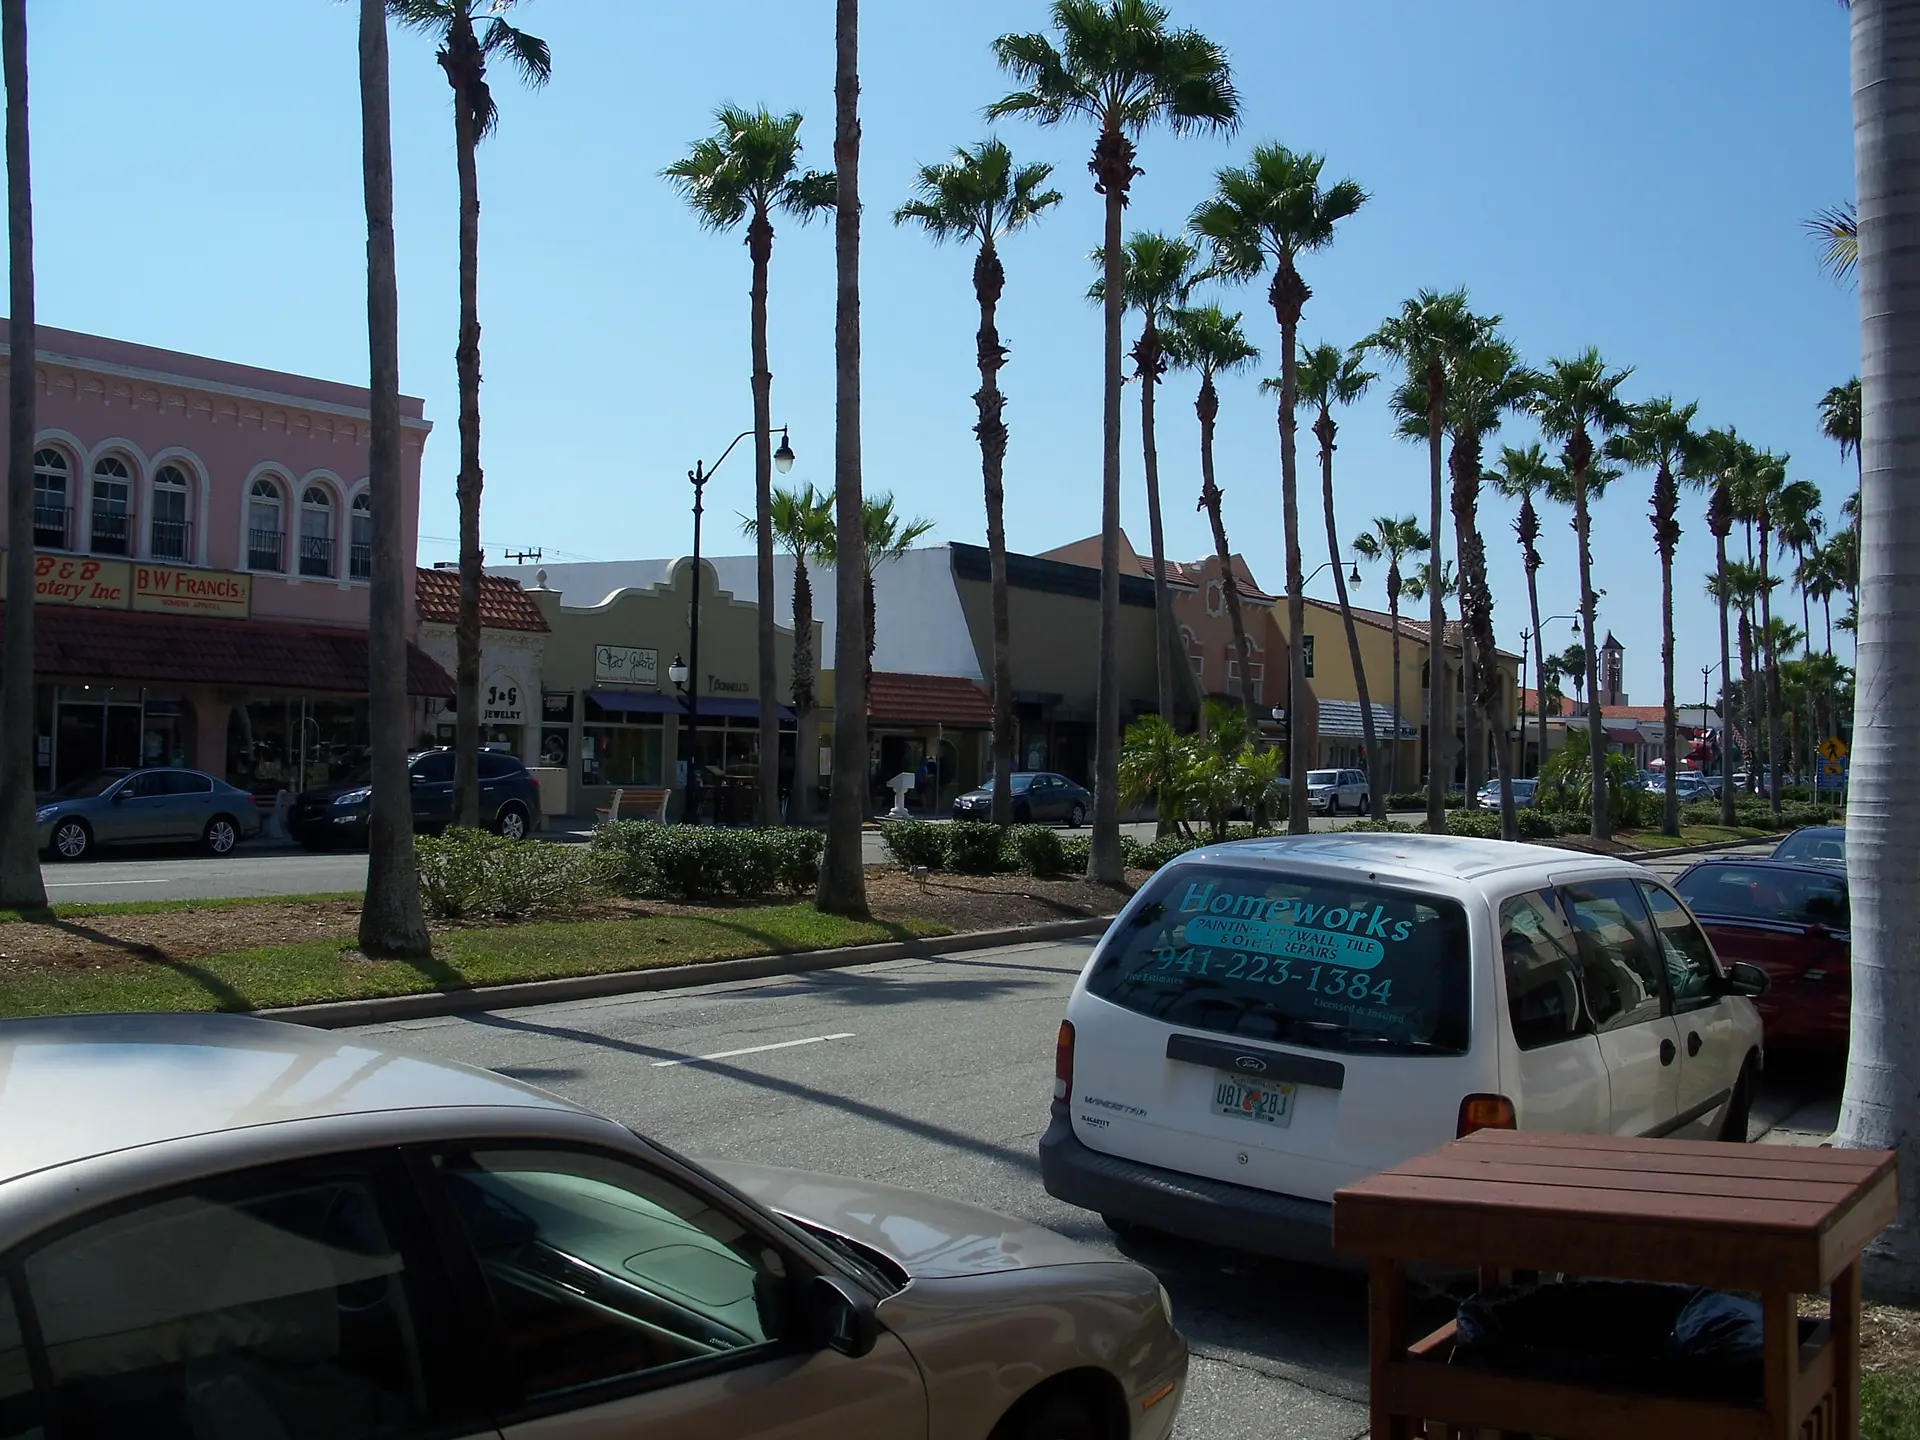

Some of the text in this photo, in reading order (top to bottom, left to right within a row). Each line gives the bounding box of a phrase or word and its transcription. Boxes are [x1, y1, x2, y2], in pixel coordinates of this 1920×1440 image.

[34, 557, 101, 580] B & B
[35, 580, 87, 602] otery
[487, 686, 517, 706] J & G
[483, 709, 521, 719] JEWELRY
[1179, 883, 1413, 942] Homeworks
[1220, 935, 1228, 944] &
[1284, 942, 1338, 960] REPAIRS
[1346, 939, 1375, 954] TILE
[1124, 971, 1184, 985] Free Estimates
[1156, 946, 1393, 1006] 941-223-1384
[1313, 997, 1405, 1023] Licensed & Insured
[1242, 1058, 1260, 1069] Ford
